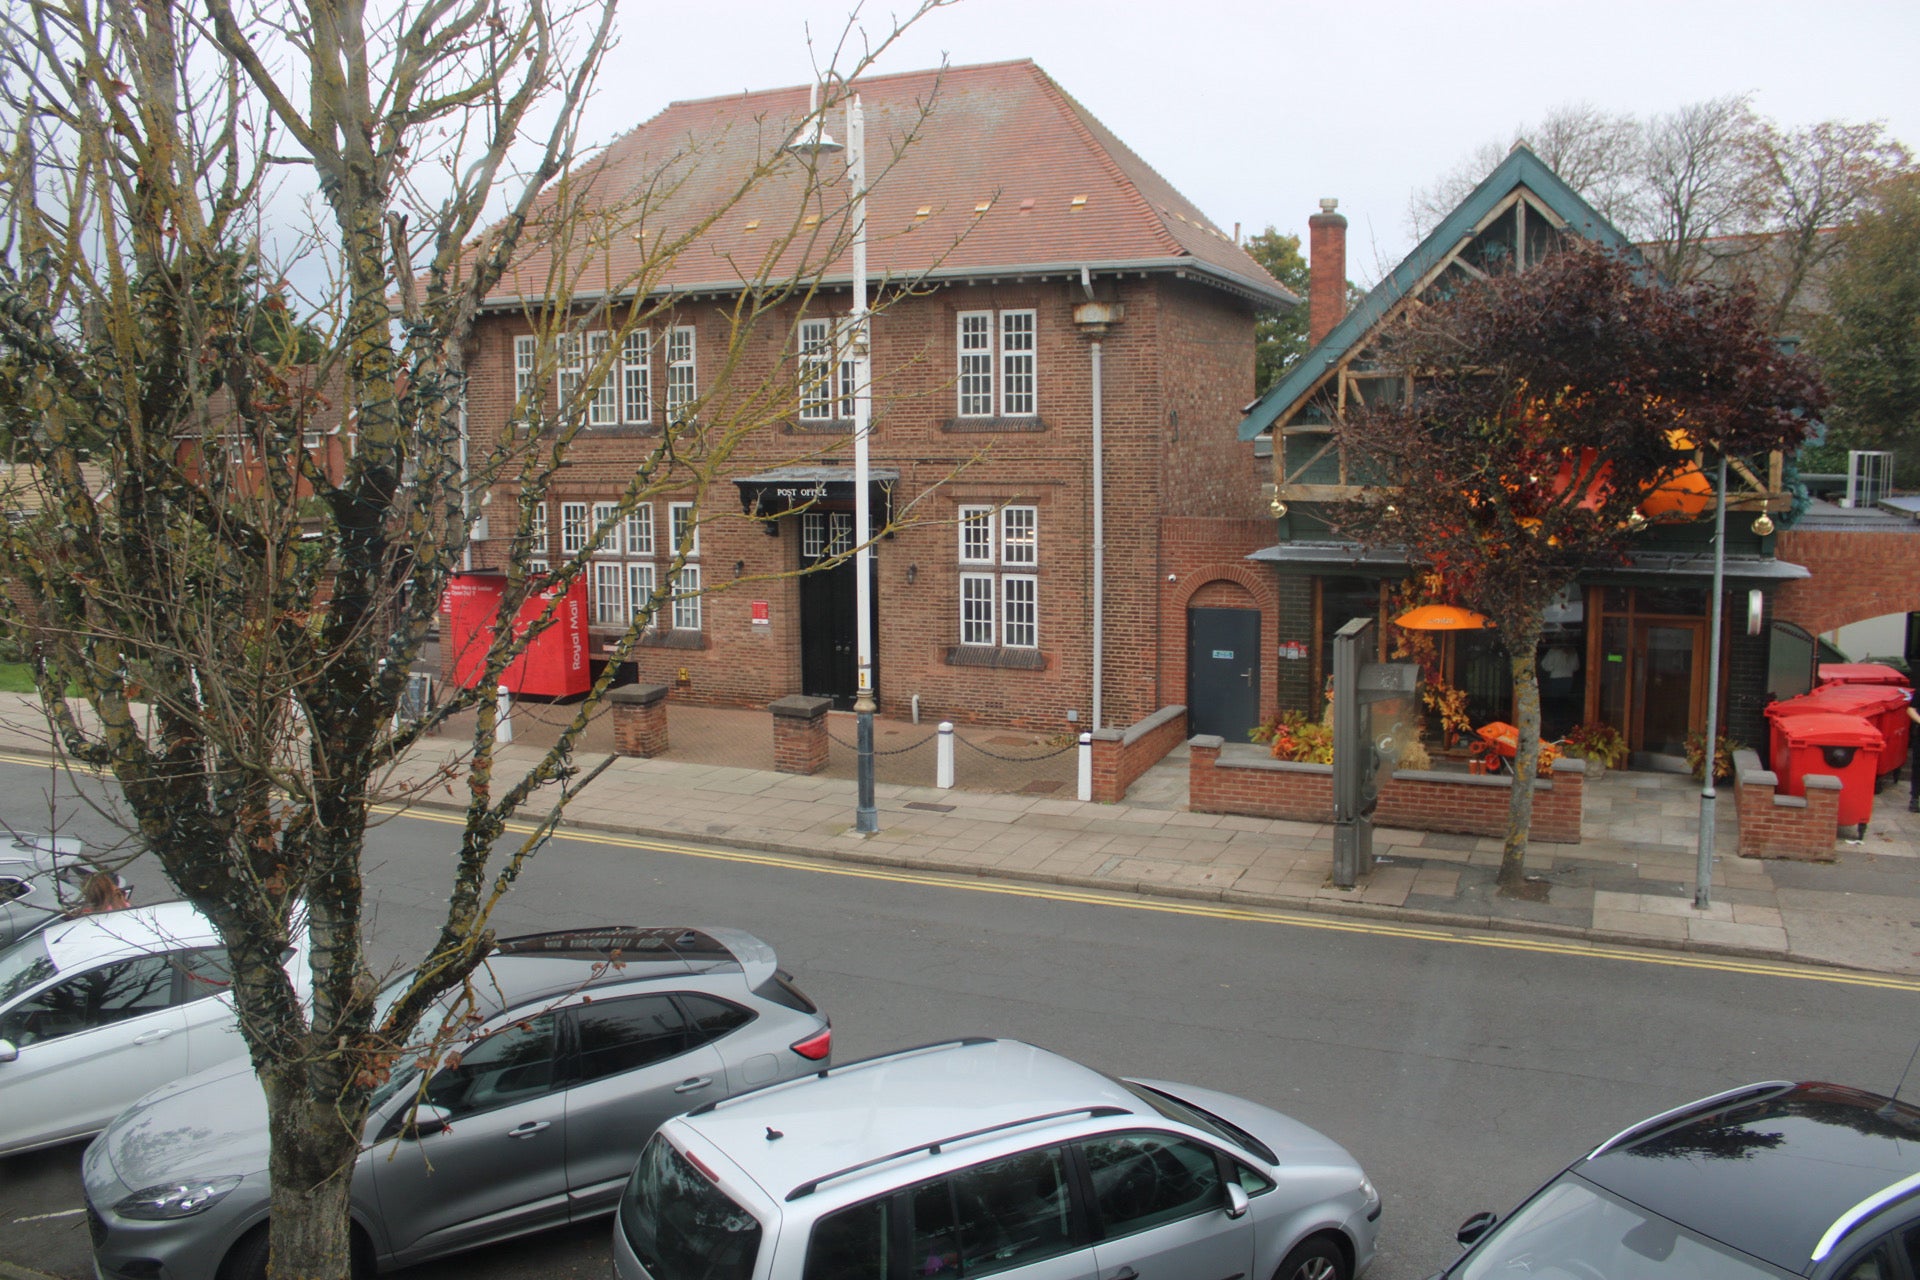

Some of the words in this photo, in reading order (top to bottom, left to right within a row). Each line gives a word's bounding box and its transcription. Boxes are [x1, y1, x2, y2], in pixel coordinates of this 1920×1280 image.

[777, 488, 797, 496] POST
[800, 488, 828, 496] OFFCE
[570, 600, 579, 629] Mail
[572, 632, 582, 670] Royal
